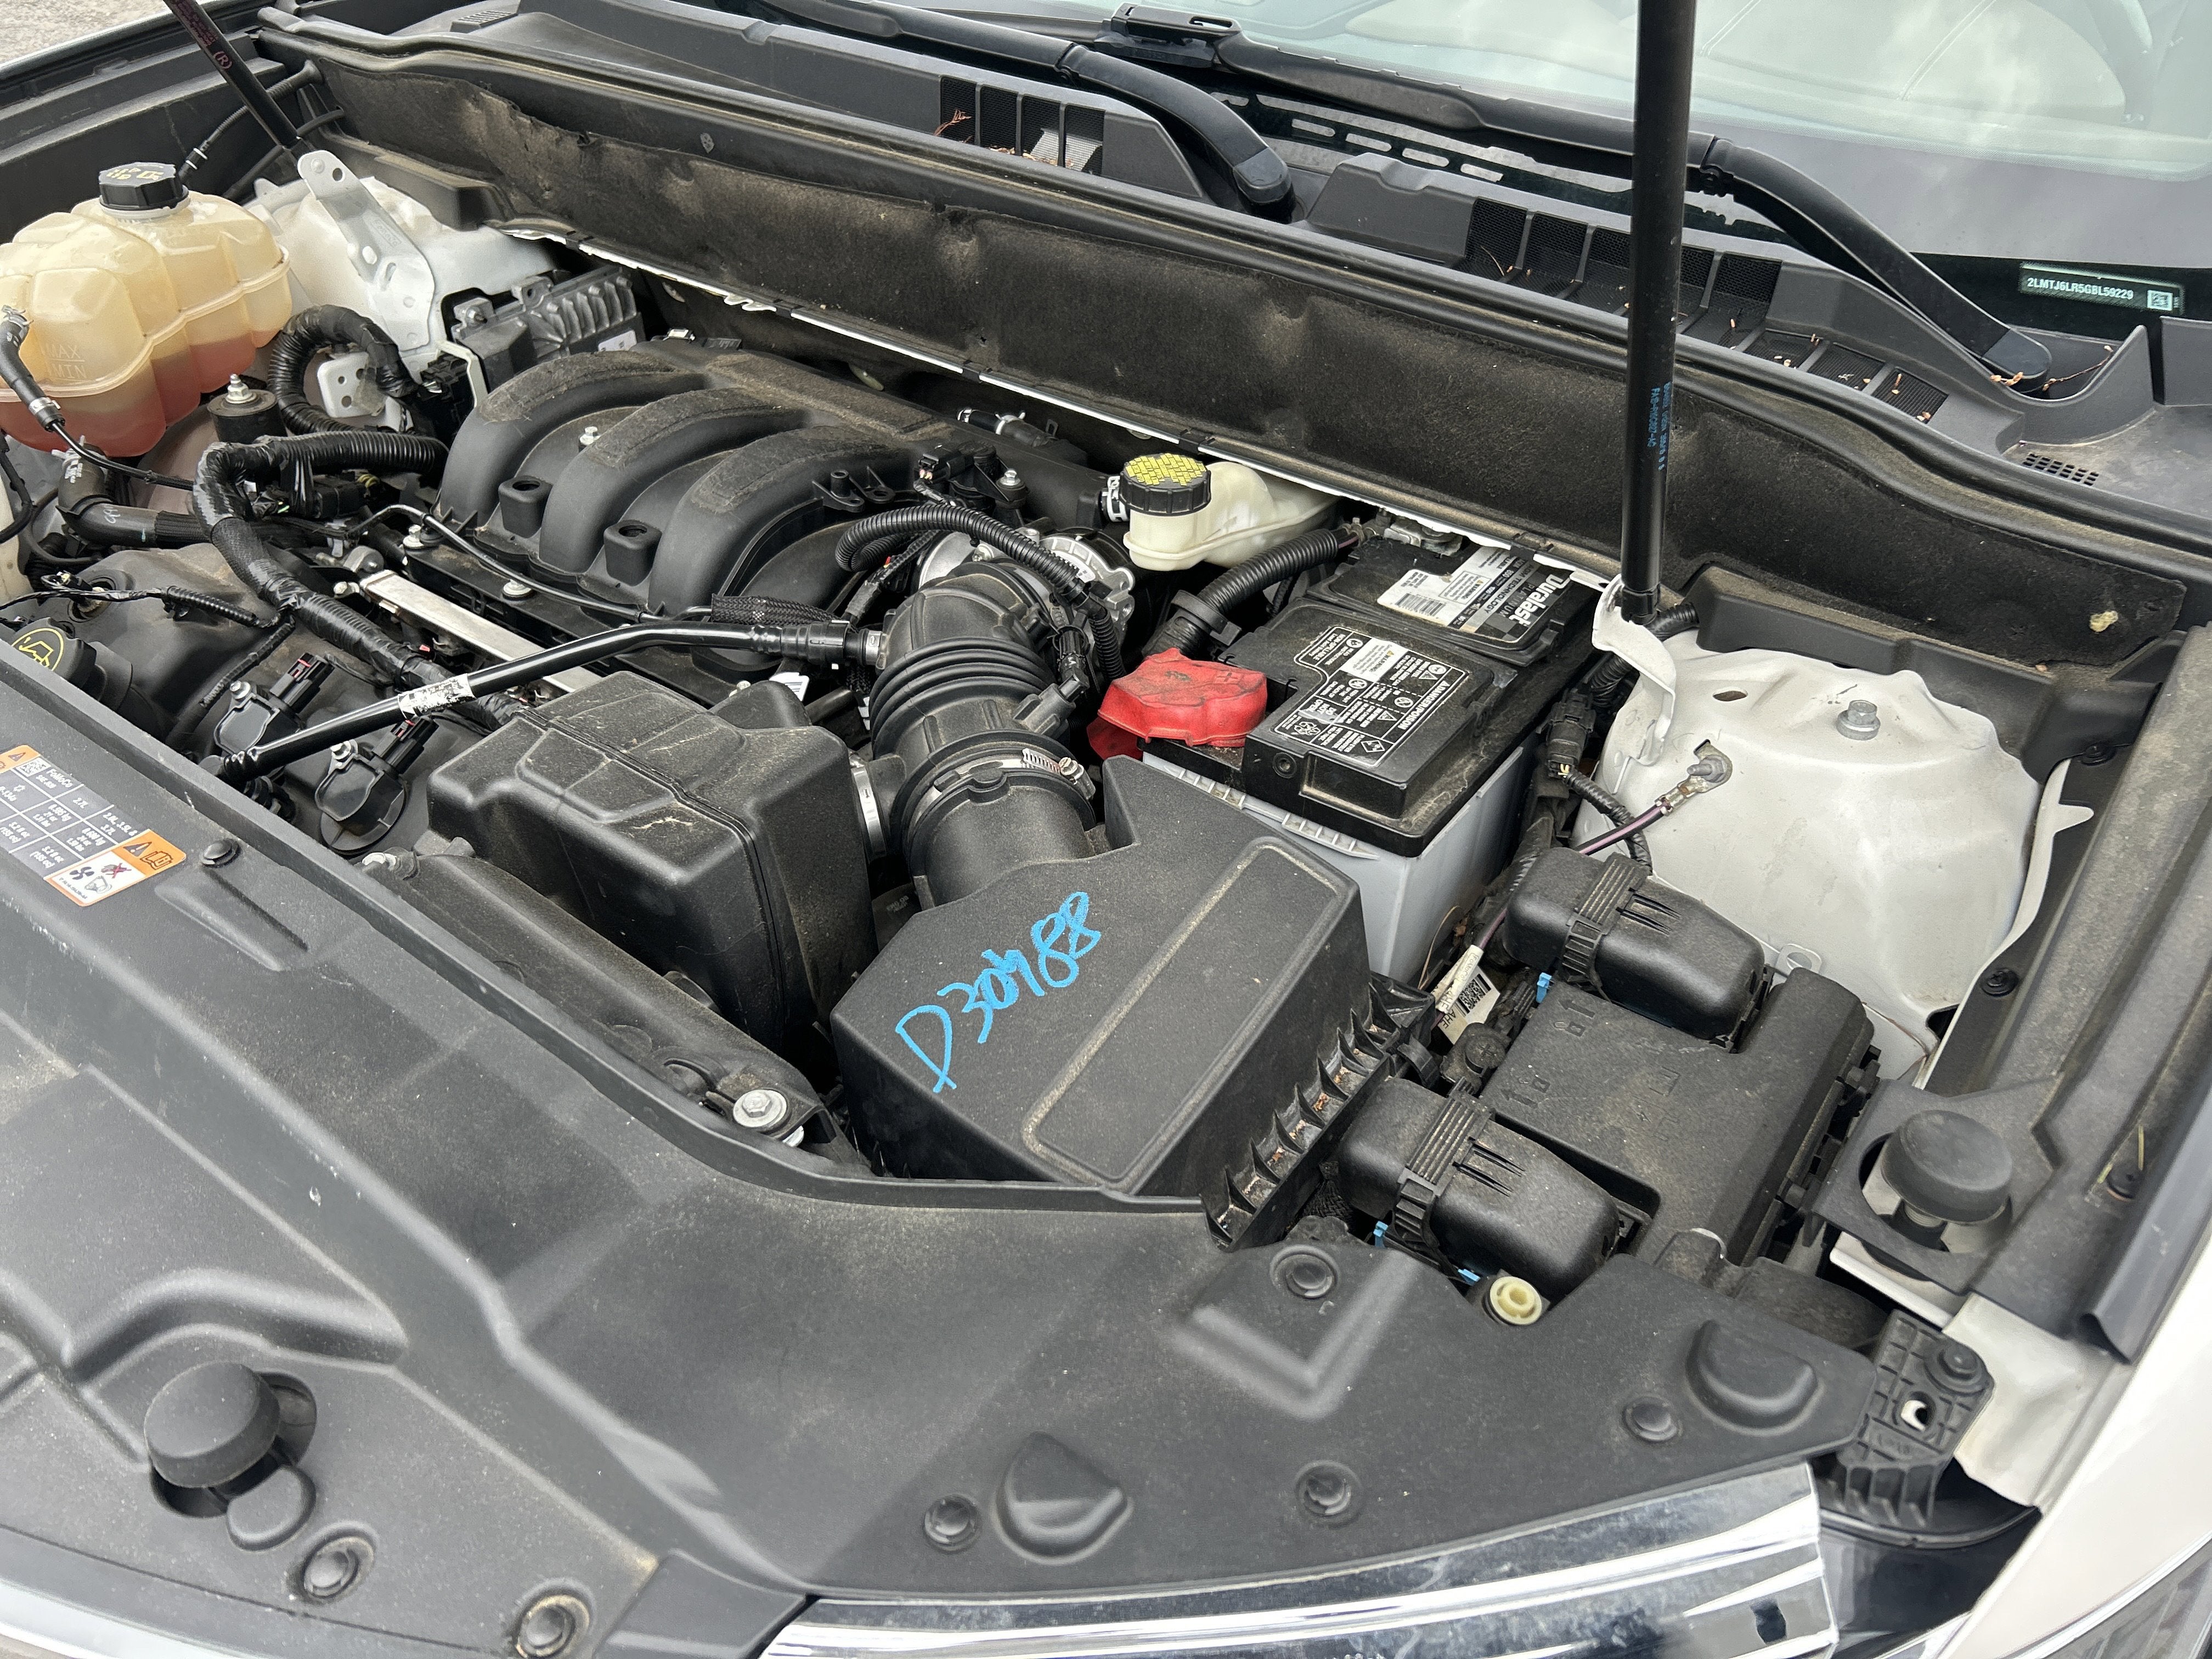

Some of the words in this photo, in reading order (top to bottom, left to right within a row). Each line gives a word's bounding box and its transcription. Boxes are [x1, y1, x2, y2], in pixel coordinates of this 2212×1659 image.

[2028, 277, 2134, 300] 2LMTJ6LR5GBL59229
[1482, 577, 1522, 613] TECHNOLOGY
[1496, 583, 1536, 617] PLATINUM
[1506, 573, 1571, 625] Duralast
[1396, 685, 1446, 730] DANGER/POISON
[46, 769, 72, 788] FoMoCo
[895, 891, 1101, 1093] D30488
[1443, 1009, 1457, 1029] AHE
